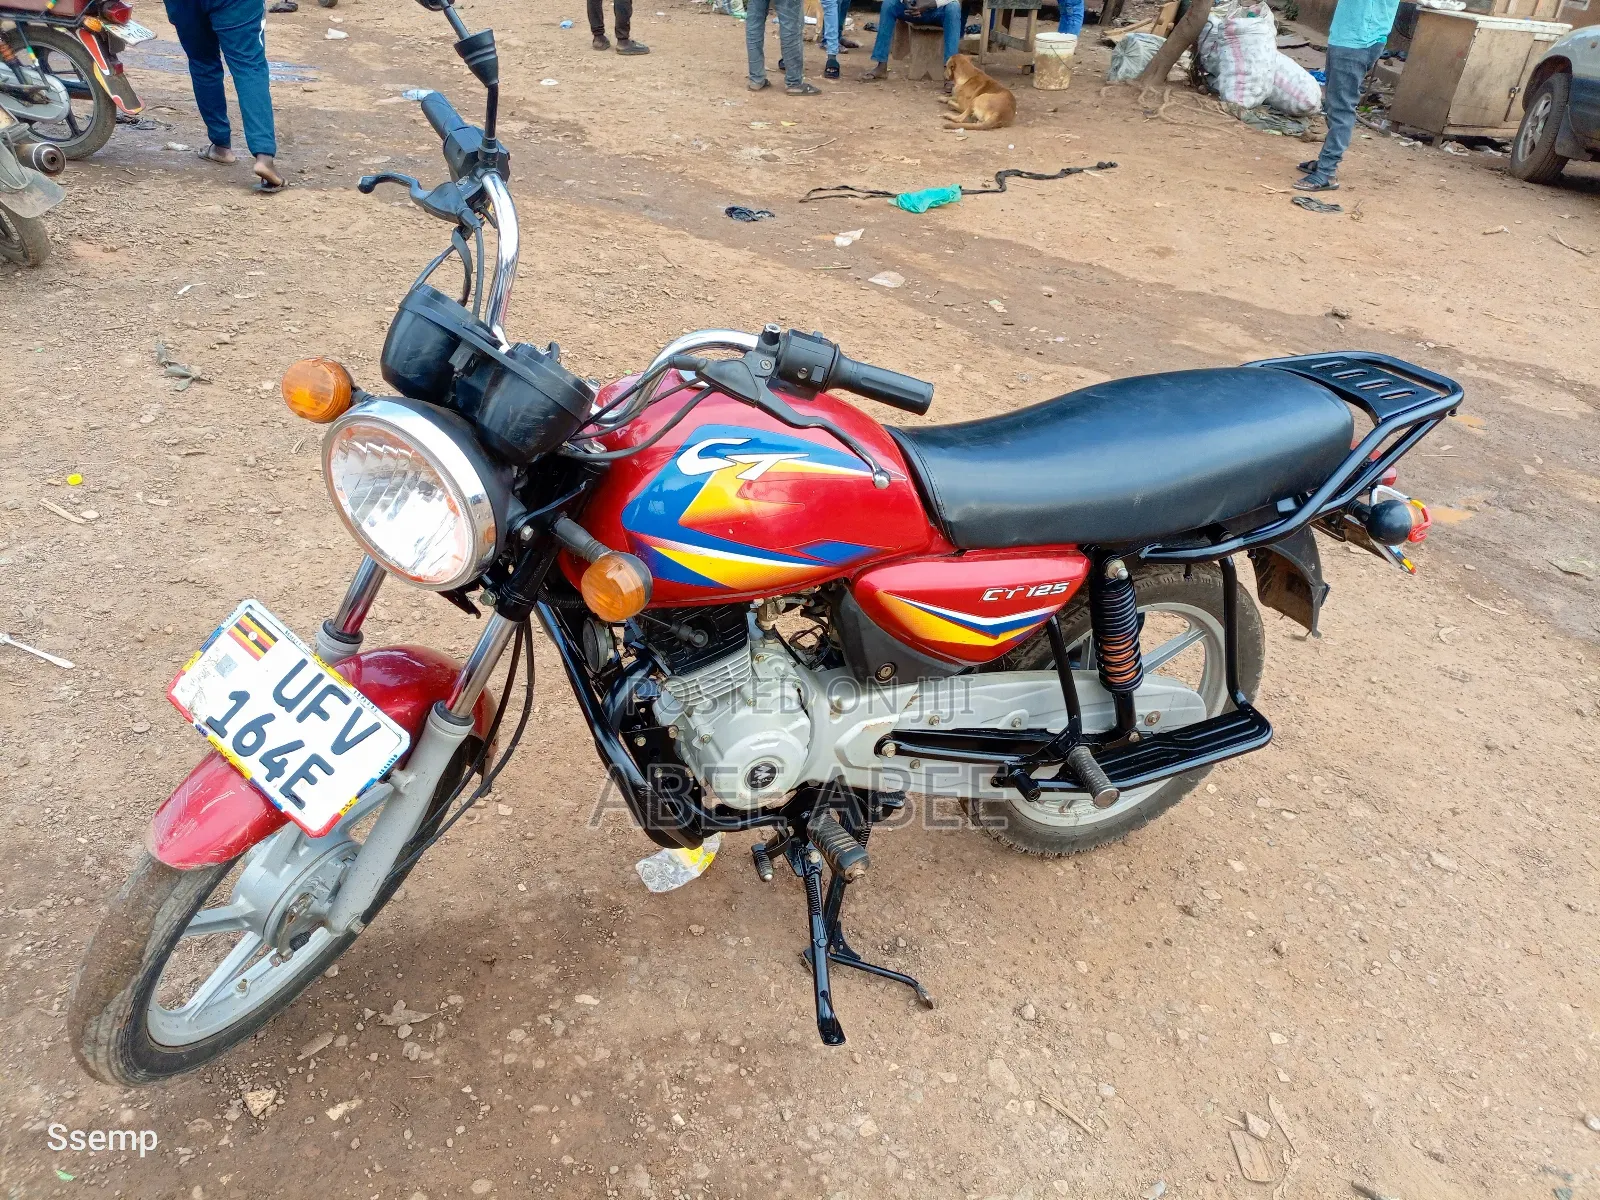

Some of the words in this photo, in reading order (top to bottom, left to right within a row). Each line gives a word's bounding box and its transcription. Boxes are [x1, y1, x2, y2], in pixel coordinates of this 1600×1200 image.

[676, 438, 810, 481] CT
[205, 690, 336, 810] 164E
[272, 658, 382, 756] UFV
